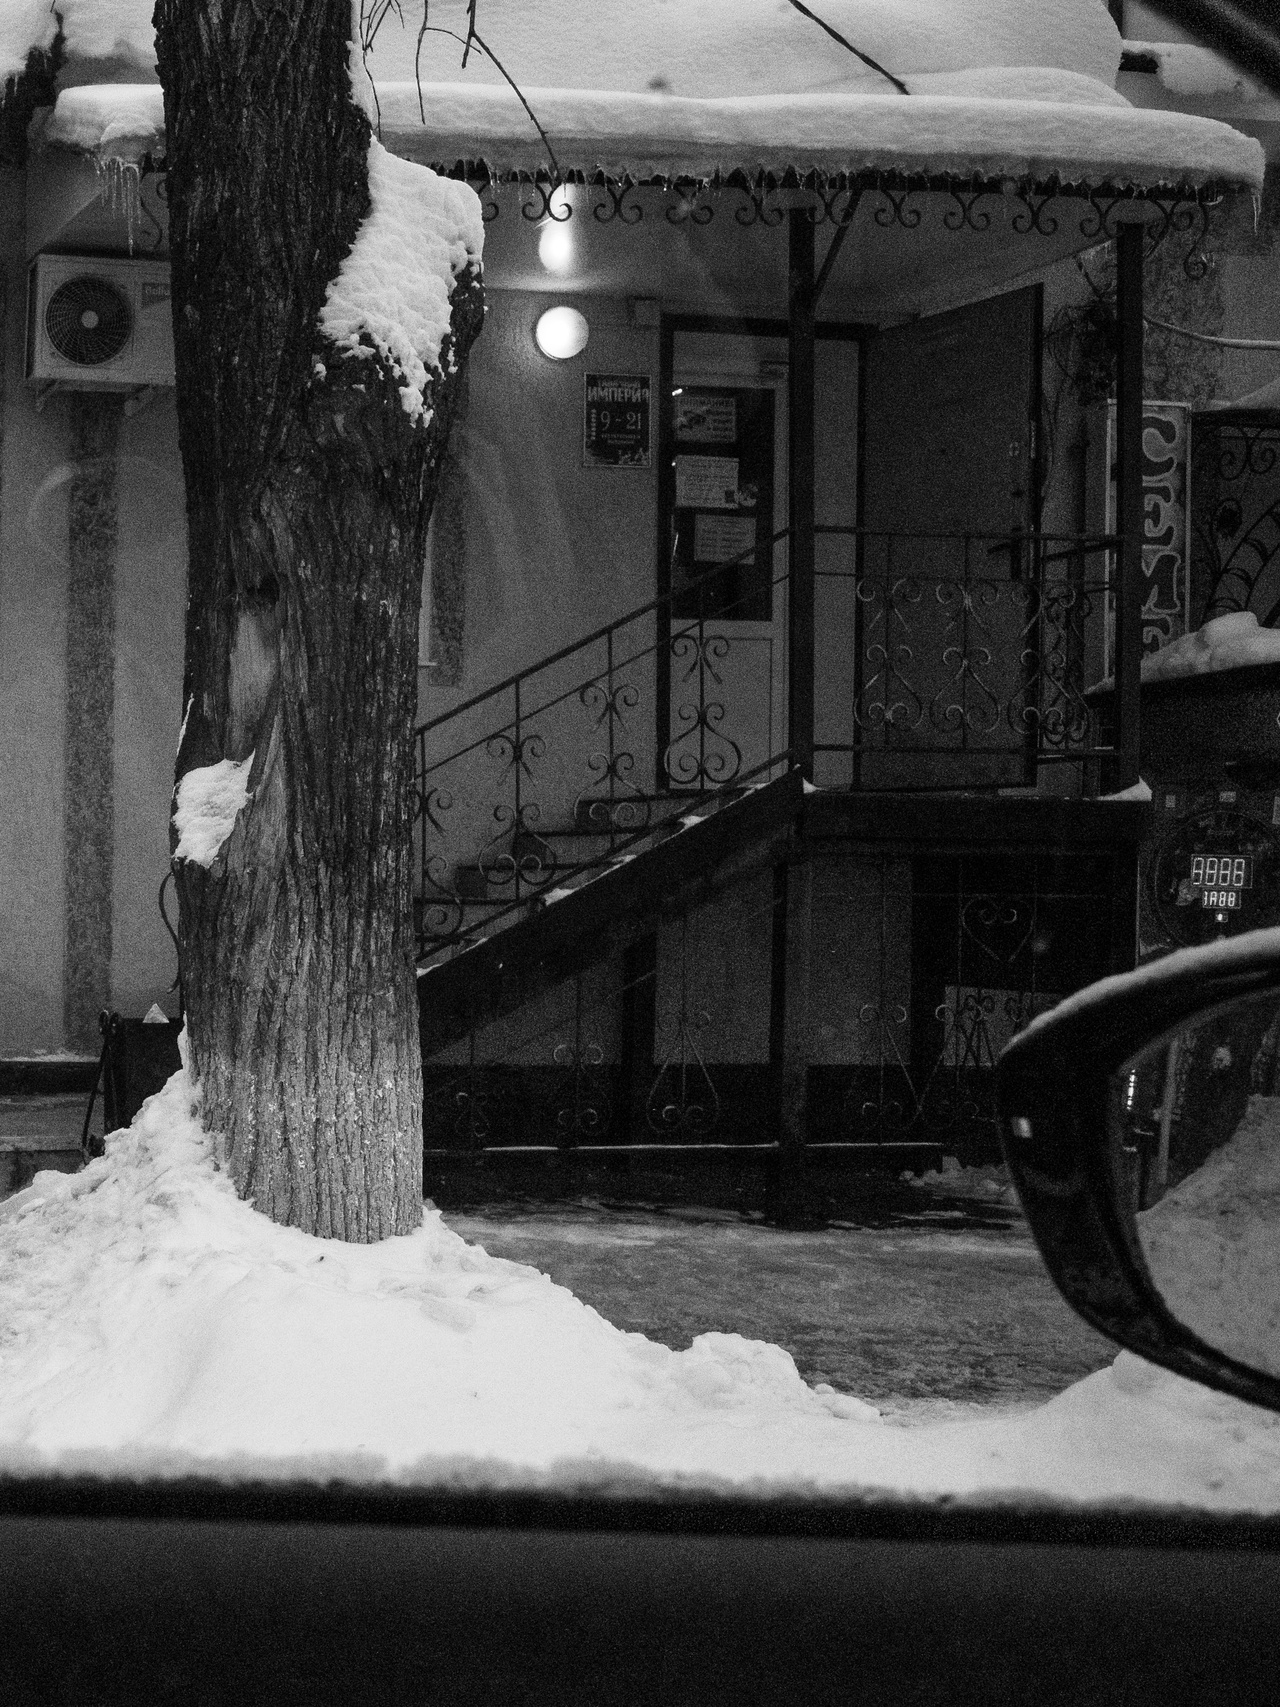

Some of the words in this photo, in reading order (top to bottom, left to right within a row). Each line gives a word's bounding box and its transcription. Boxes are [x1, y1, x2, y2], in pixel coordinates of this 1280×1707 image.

[587, 386, 650, 403] ИМПЕРИЯ
[600, 411, 611, 431] 9
[626, 411, 641, 430] 21
